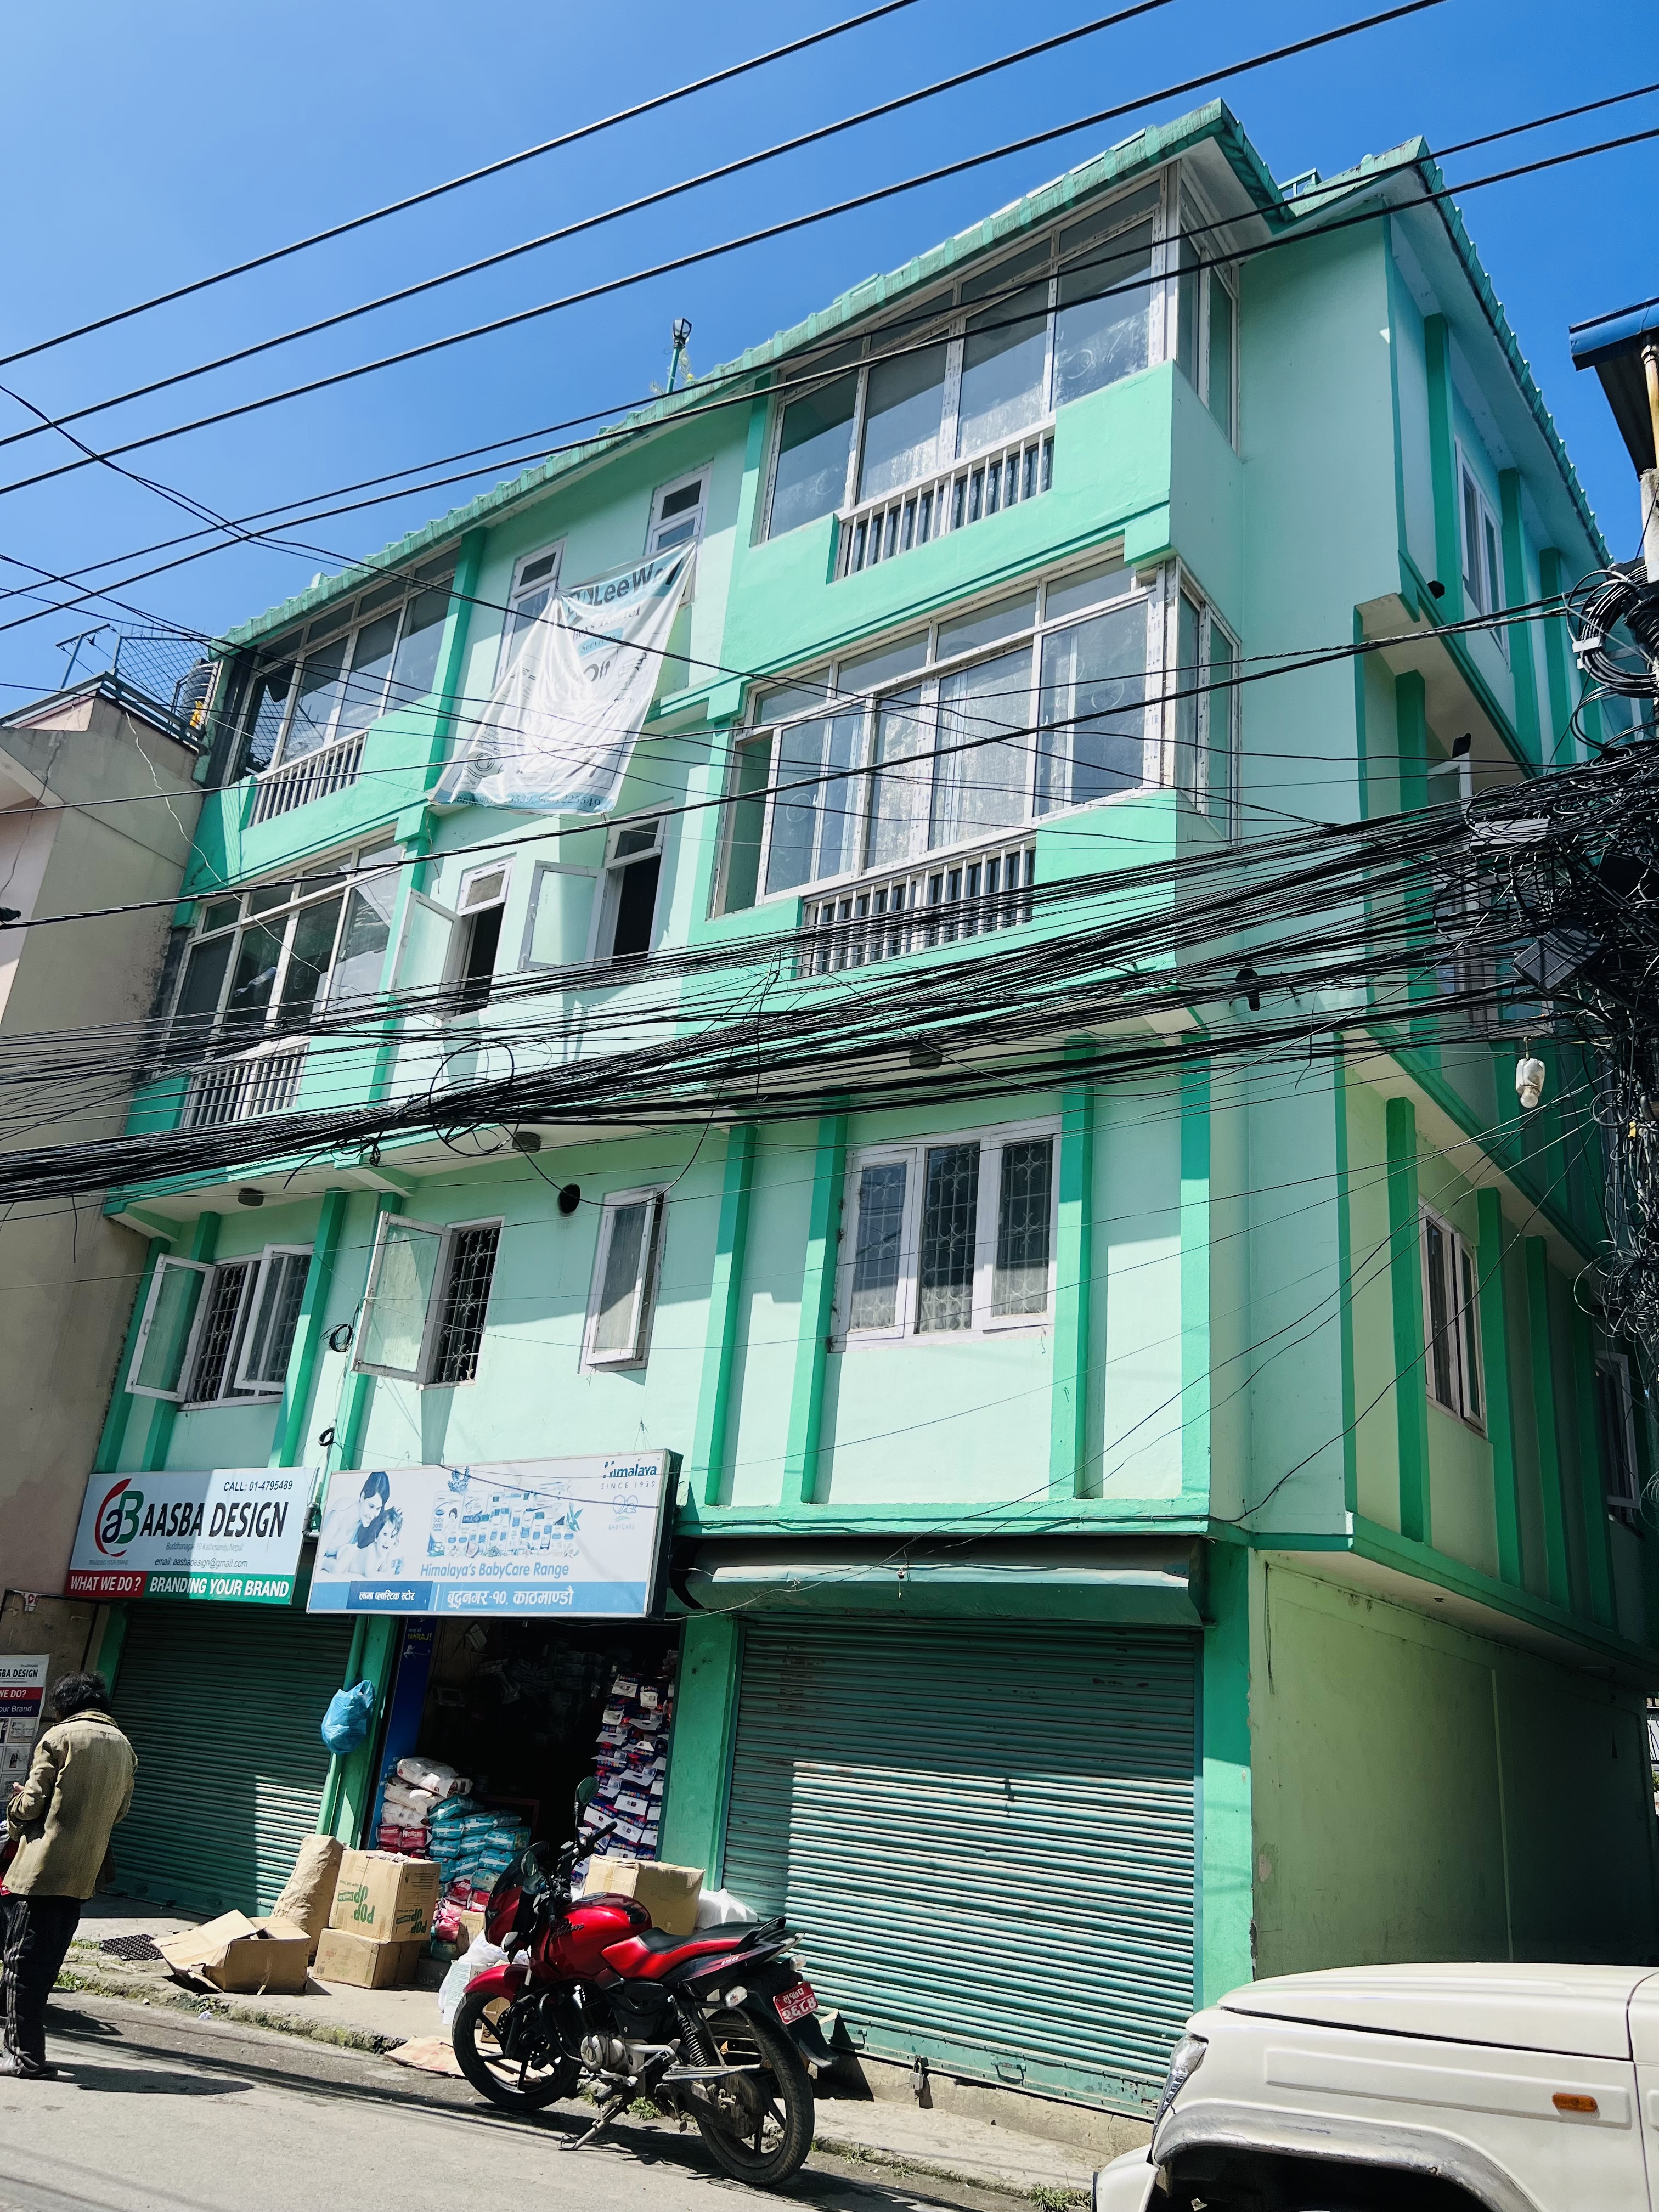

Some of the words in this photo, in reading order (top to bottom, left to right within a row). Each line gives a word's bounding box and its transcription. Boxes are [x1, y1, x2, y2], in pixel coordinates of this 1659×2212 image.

[602, 1458, 657, 1479] Himalaya
[223, 1481, 247, 1492] CALL:
[249, 1480, 294, 1491] 01-4795489
[601, 1482, 629, 1490] SINCE
[634, 1480, 656, 1488] 1930
[139, 1502, 205, 1537] AASBA
[208, 1501, 289, 1538] DESIGN
[173, 1558, 248, 1569] aasbadesign@gmail.com
[479, 1562, 530, 1580] BabyCare
[534, 1562, 569, 1579] Range
[70, 1575, 100, 1592] WHAT
[101, 1577, 116, 1591] WE
[149, 1578, 207, 1594] BRANDING
[209, 1578, 244, 1595] YOUR
[244, 1579, 289, 1597] BRAND
[359, 1592, 374, 1600] लामा
[13, 1669, 38, 1678] DESIGN
[10, 1690, 27, 1698] DO?
[354, 1903, 375, 1925] POP
[410, 1920, 428, 1934] POP
